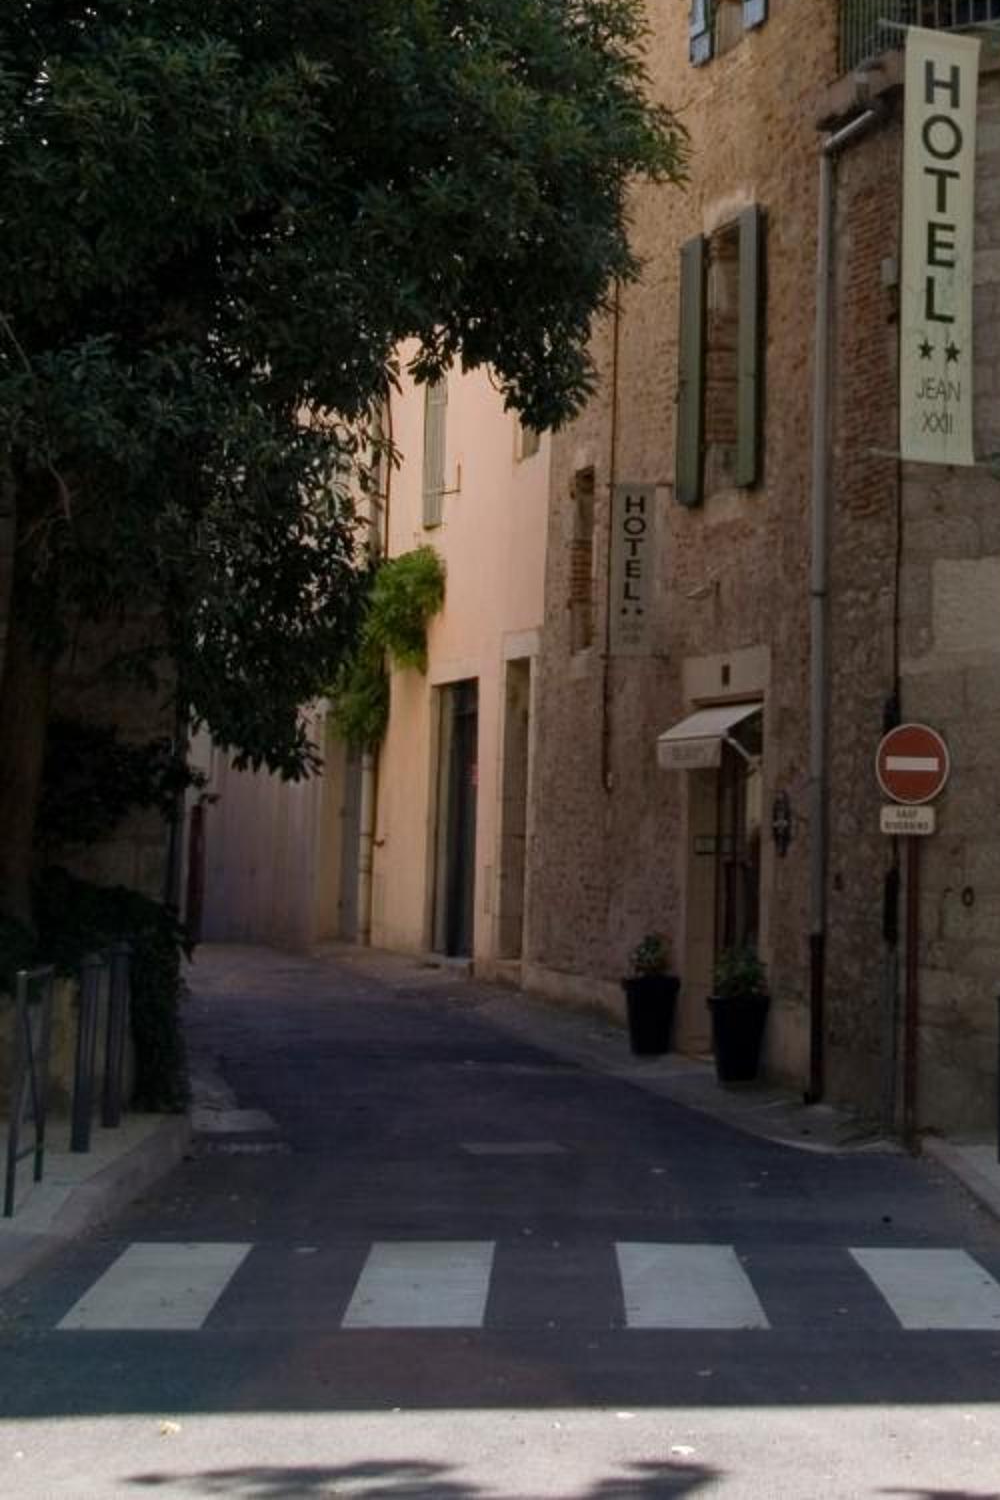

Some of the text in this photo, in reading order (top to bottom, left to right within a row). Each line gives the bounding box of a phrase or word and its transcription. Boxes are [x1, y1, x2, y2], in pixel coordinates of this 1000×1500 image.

[922, 61, 963, 324] HOTEL
[915, 376, 961, 401] JEAN
[623, 496, 646, 601] HOTEL
